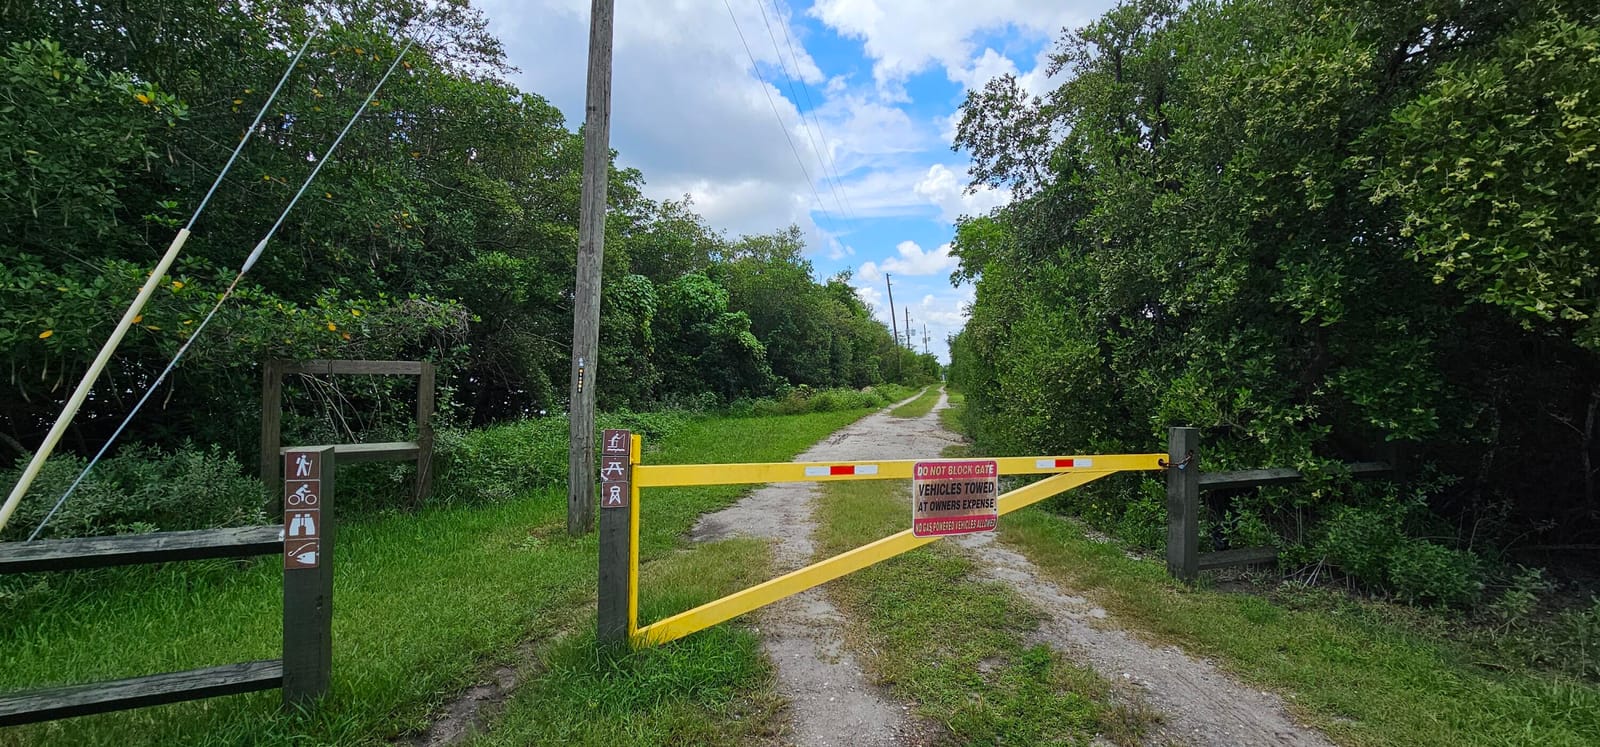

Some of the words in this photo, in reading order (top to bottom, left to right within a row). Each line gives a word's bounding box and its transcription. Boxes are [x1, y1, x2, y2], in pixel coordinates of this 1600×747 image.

[917, 466, 928, 476] DO
[930, 466, 947, 476] NOT
[948, 466, 972, 475] BLOCK
[975, 465, 994, 474] GATE
[919, 483, 962, 496] VEHICLES
[965, 482, 994, 494] TOWED
[918, 502, 928, 512] AT
[930, 500, 960, 511] OWNERS
[963, 499, 994, 509] EXPENSE
[916, 524, 921, 532] NO
[923, 523, 932, 532] GAS
[933, 521, 954, 531] POWERED
[955, 520, 976, 530] VEHICLES
[977, 519, 995, 527] ALLOWED
